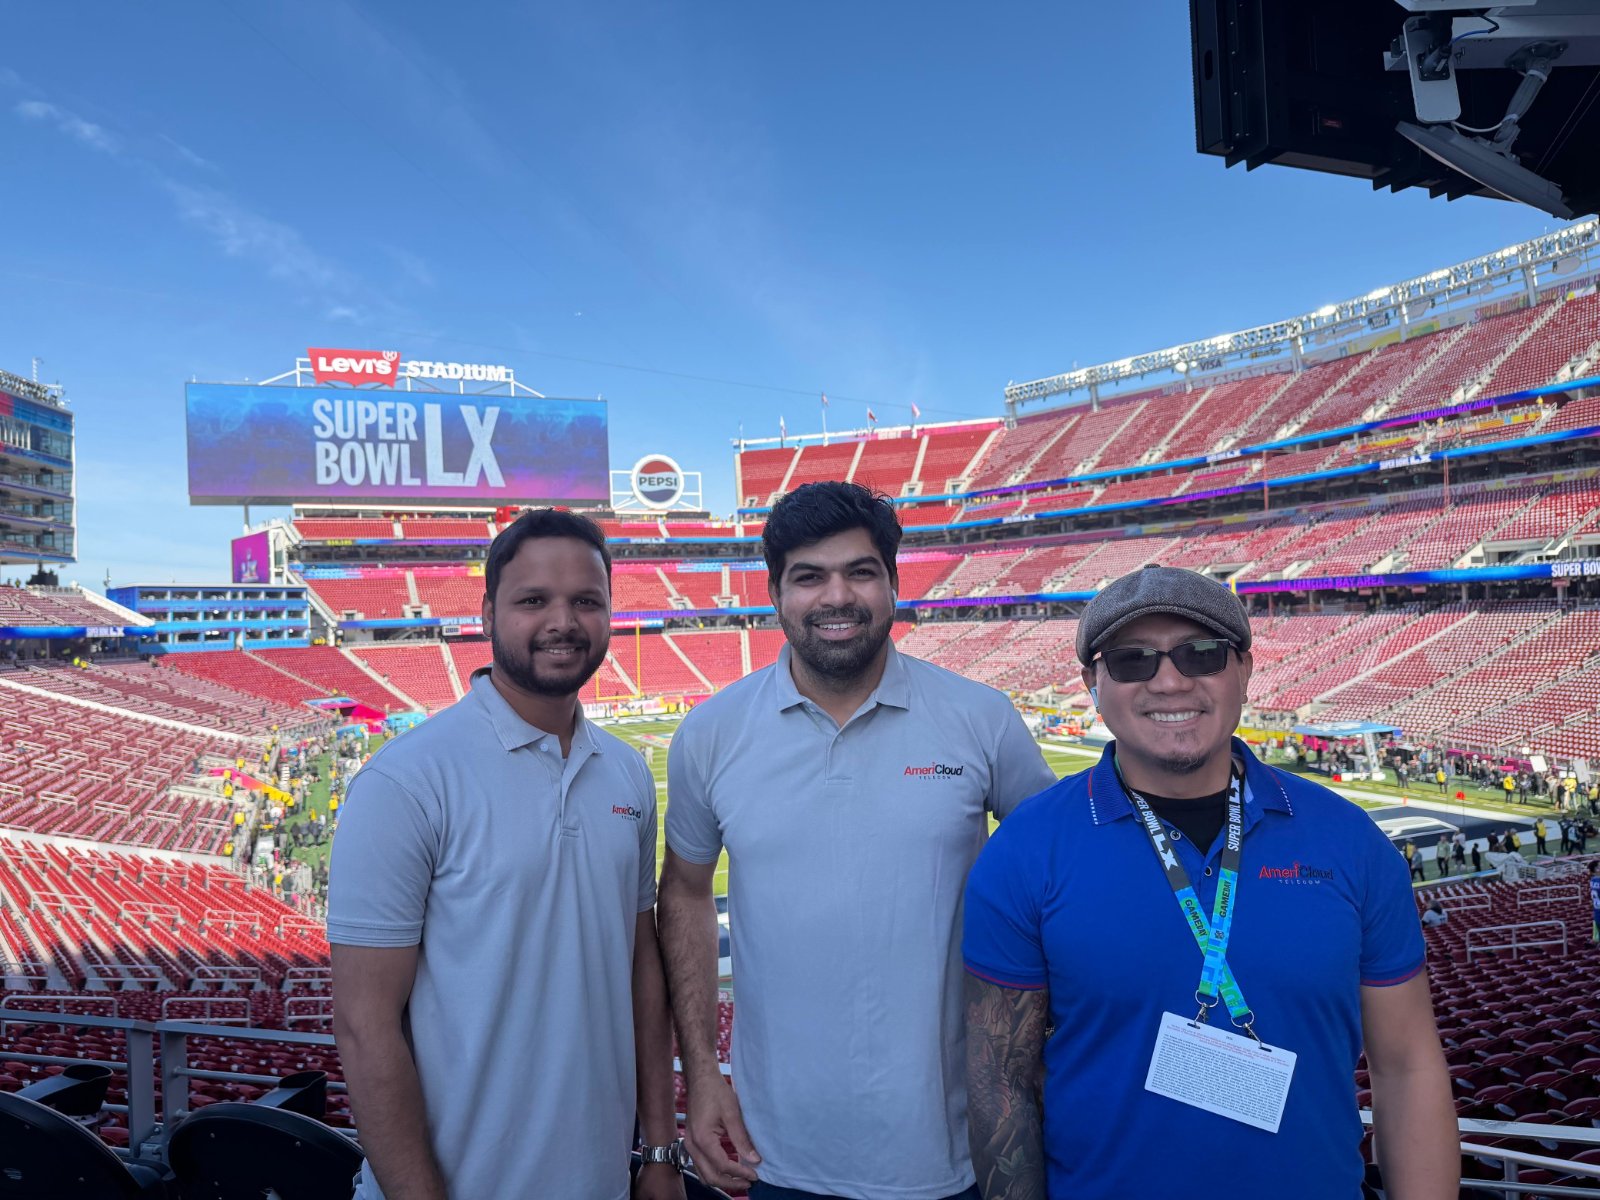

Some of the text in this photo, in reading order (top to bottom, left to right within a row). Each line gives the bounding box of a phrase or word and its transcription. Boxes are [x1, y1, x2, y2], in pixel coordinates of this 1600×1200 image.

[406, 360, 506, 382] STADIUM
[1200, 359, 1222, 371] VISA
[312, 398, 418, 441] SUPER
[315, 441, 421, 486] BOWL
[423, 402, 507, 488] LX
[639, 476, 677, 487] PEPSI
[1356, 574, 1385, 587] AREA
[1551, 562, 1582, 578] SUPER
[904, 761, 964, 776] AmeriCloud
[1228, 775, 1242, 852] SUPER BOWL LX
[1142, 810, 1162, 835] BOWL
[1152, 833, 1179, 871] LX
[1185, 899, 1208, 937] GAMEDAY
[1219, 880, 1232, 918] GAMEDAY
